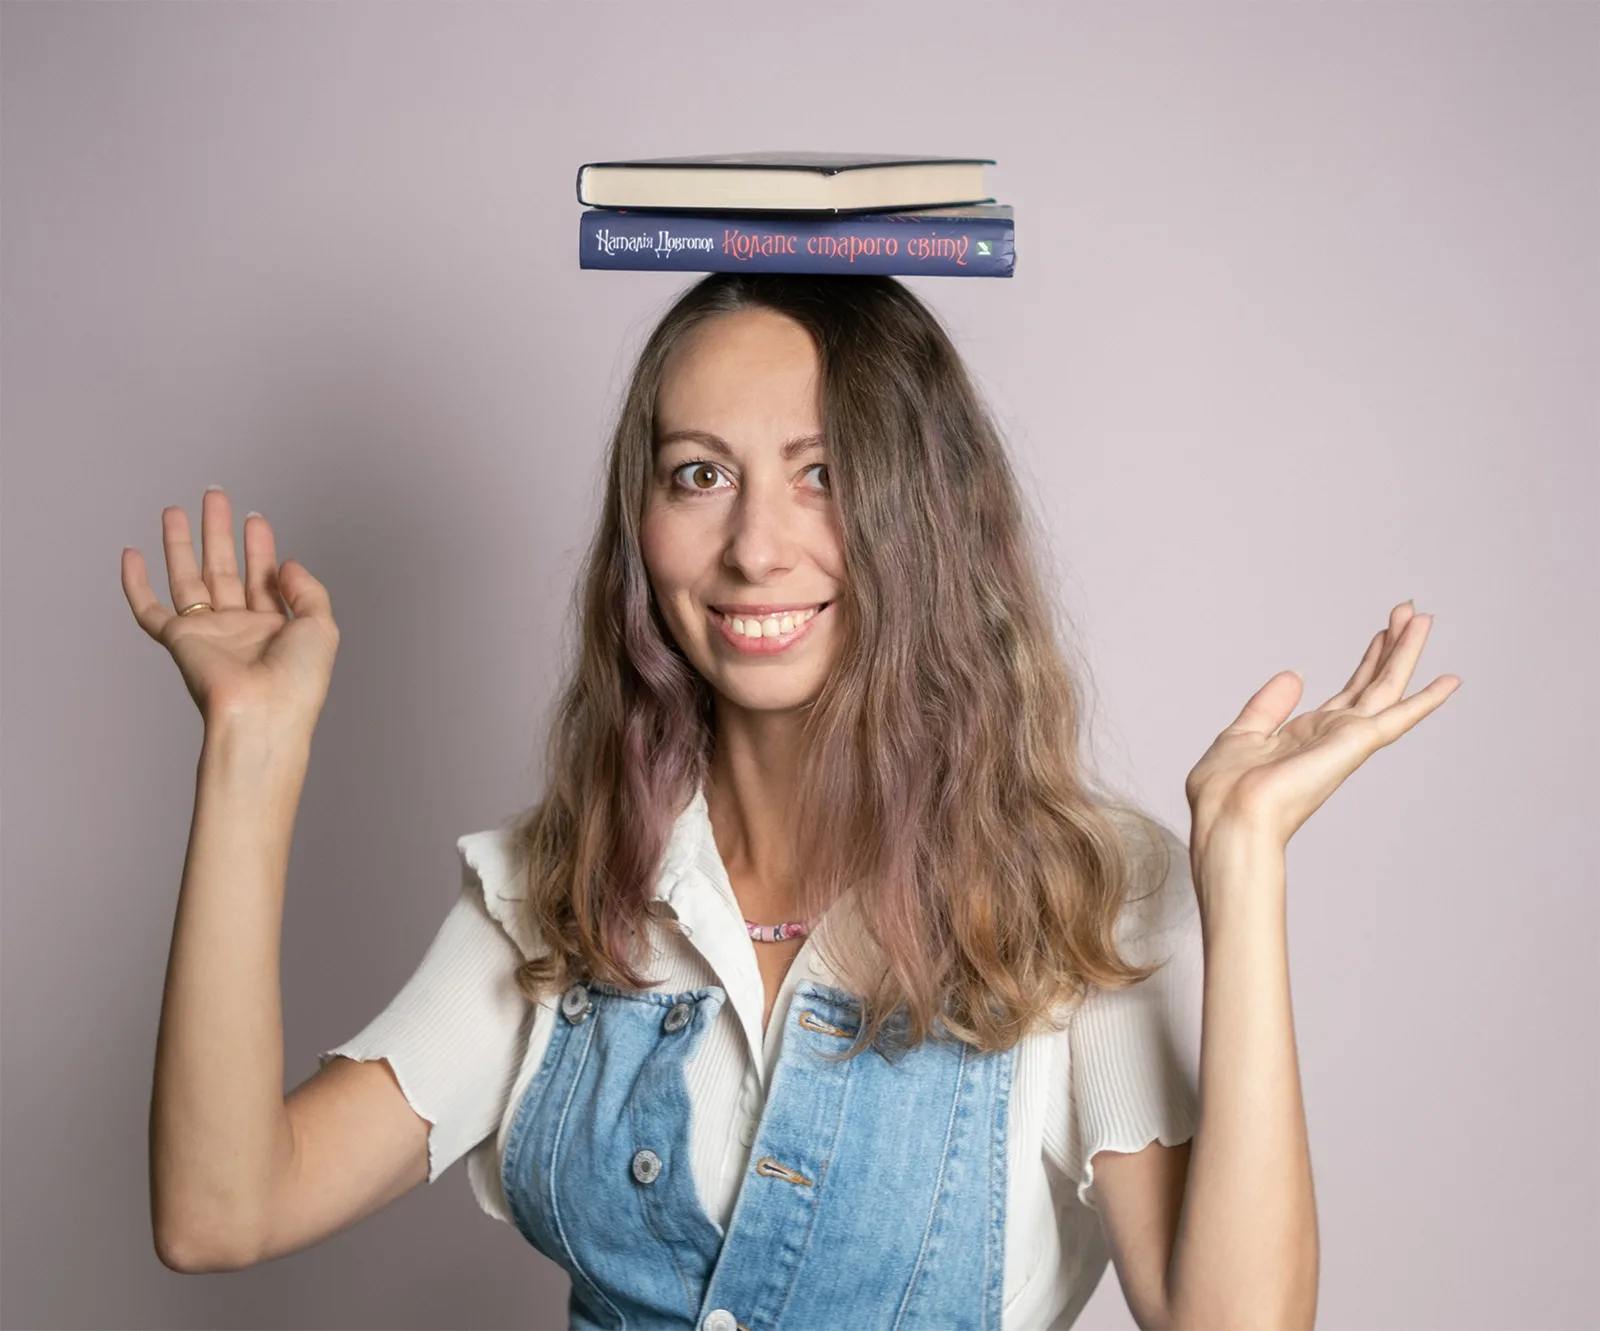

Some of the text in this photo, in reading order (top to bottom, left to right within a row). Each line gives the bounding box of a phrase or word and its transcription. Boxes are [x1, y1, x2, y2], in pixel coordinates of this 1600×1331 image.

[596, 229, 969, 266] Наталія Довгопол Колапс старого світу
